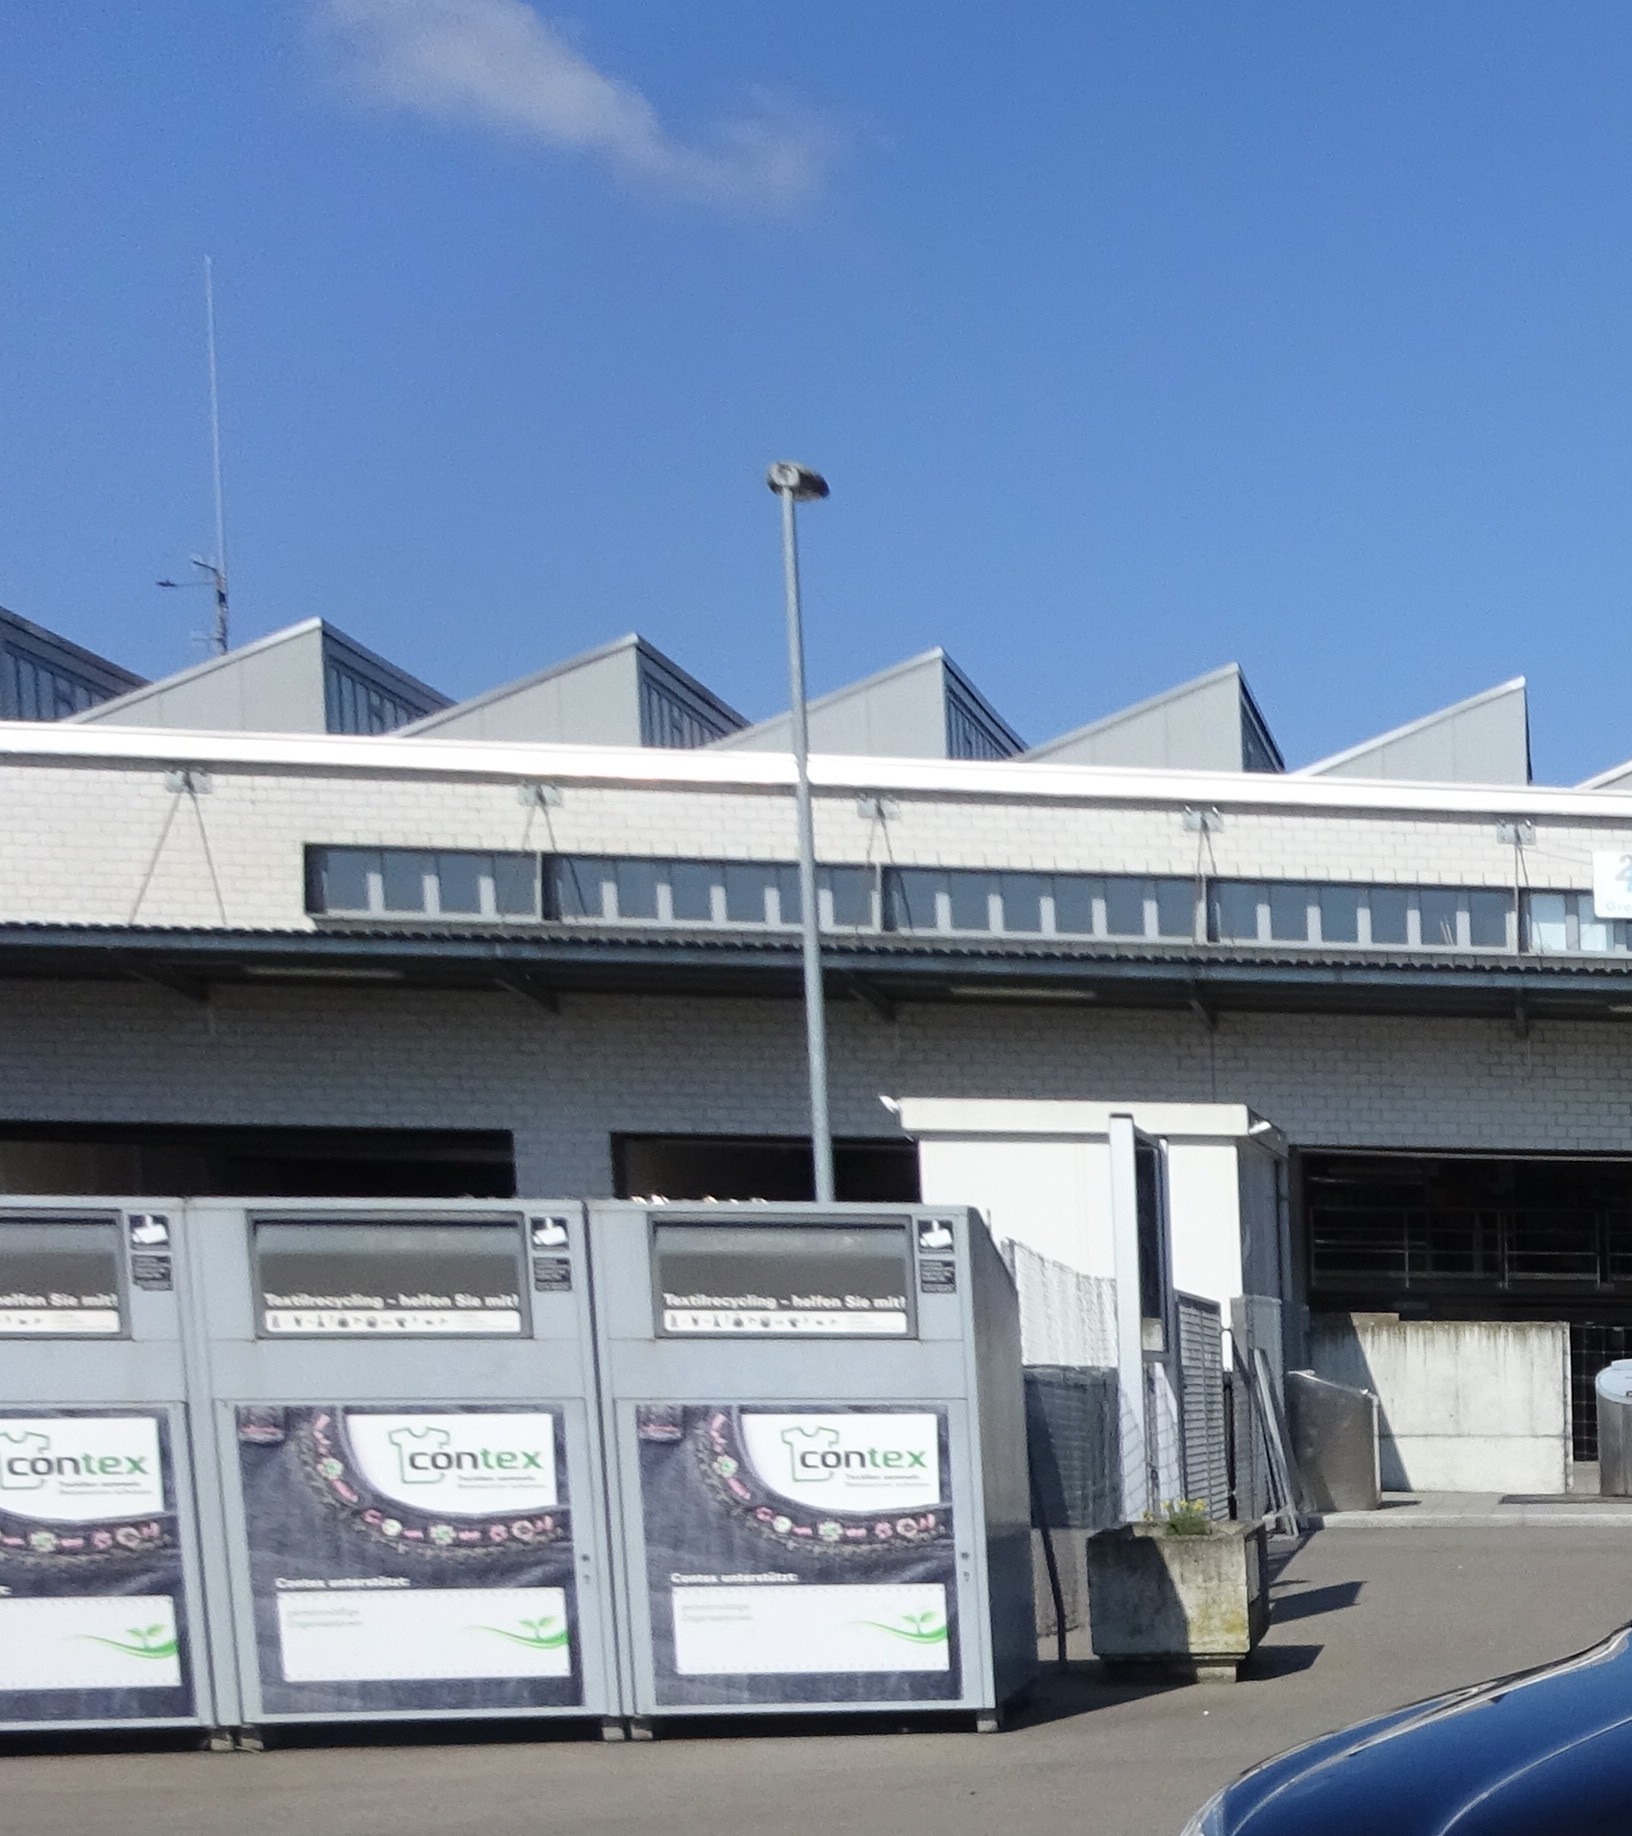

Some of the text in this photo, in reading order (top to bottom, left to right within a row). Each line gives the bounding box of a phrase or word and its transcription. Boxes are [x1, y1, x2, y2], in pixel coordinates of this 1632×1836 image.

[263, 1293, 384, 1309] Textilrecycling
[399, 1293, 451, 1308] helfen
[454, 1293, 481, 1308] Sie
[484, 1294, 519, 1308] mit!
[663, 1293, 778, 1309] Textilrecycling
[791, 1293, 842, 1308] helfen
[845, 1294, 870, 1308] Sie
[873, 1295, 906, 1309] mit!
[7, 1453, 149, 1476] contex
[408, 1448, 543, 1471] contex
[800, 1448, 927, 1469] contex
[670, 1572, 719, 1584] Contex
